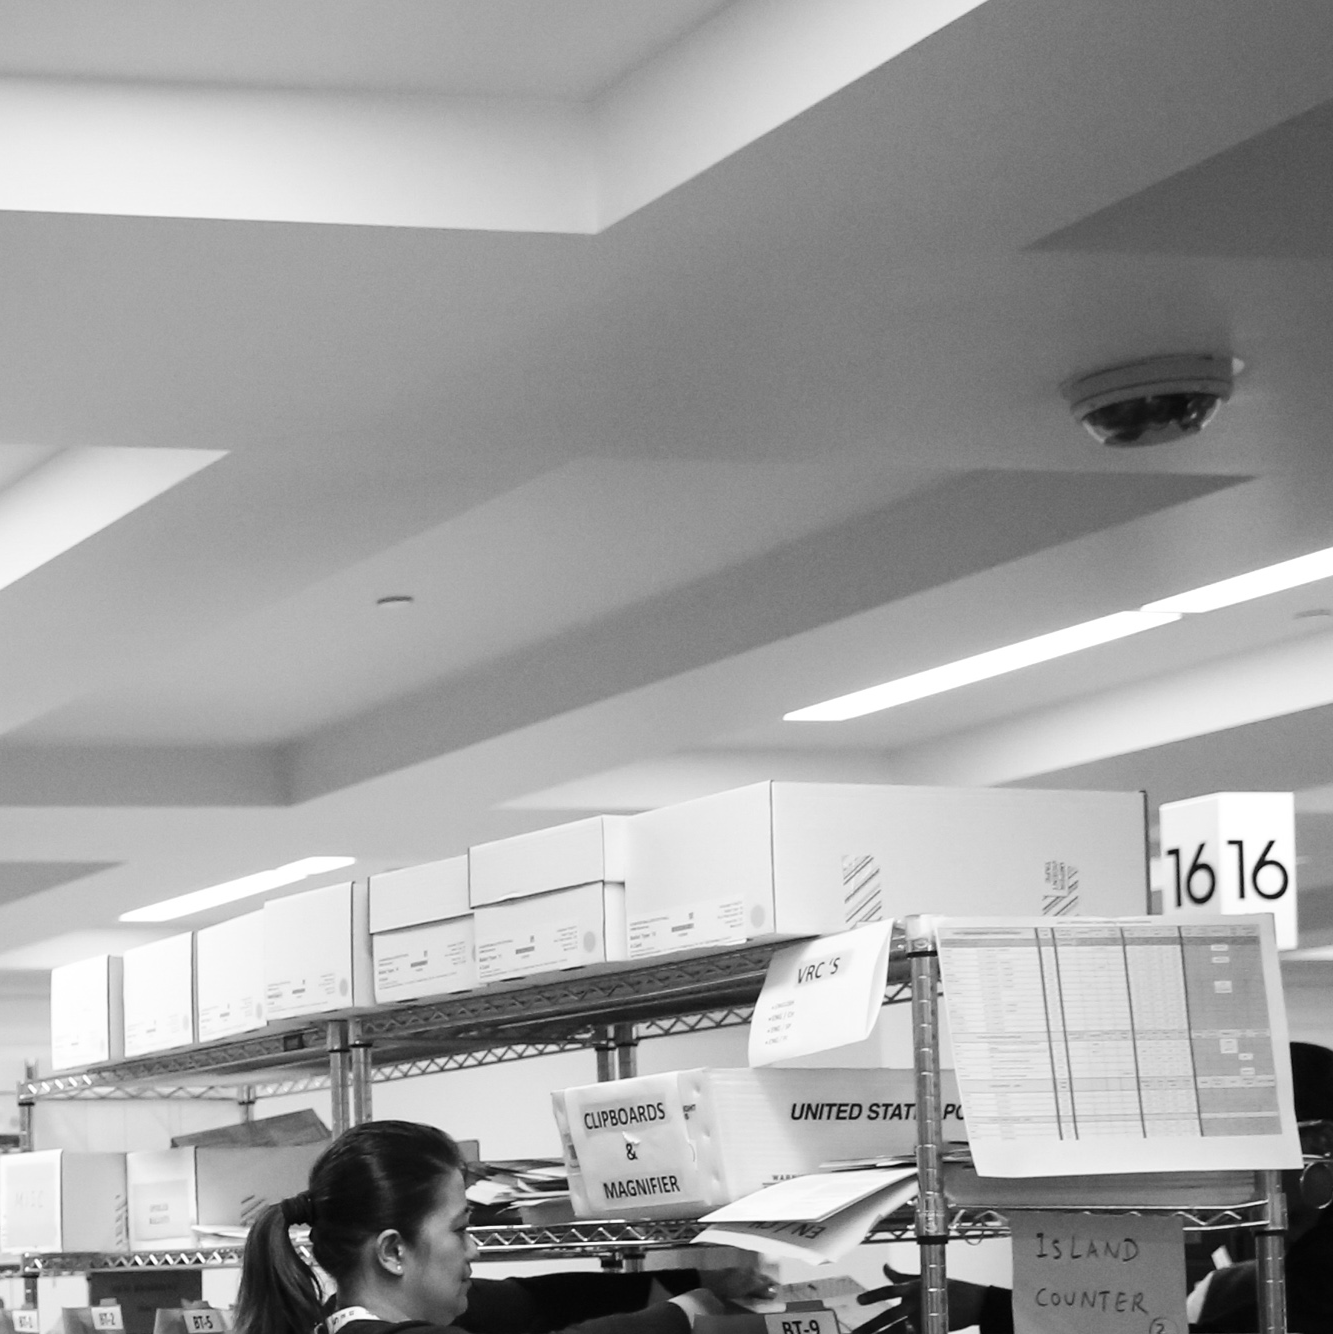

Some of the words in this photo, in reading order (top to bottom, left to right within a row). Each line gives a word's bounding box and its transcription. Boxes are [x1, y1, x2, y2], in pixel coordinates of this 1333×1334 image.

[1167, 842, 1217, 908] 16
[1227, 839, 1289, 901] 16
[797, 961, 825, 984] VRC
[584, 1102, 666, 1130] CLIPBOARDS
[790, 1103, 863, 1121] UNITED
[867, 1103, 916, 1120] STAT
[626, 1142, 637, 1161] &
[603, 1174, 681, 1200] MAGNIFIER
[1035, 1232, 1140, 1263] ISLAND
[1035, 1287, 1149, 1315] COUNTER
[98, 1312, 117, 1326] BT-2
[192, 1315, 214, 1329] BT-5
